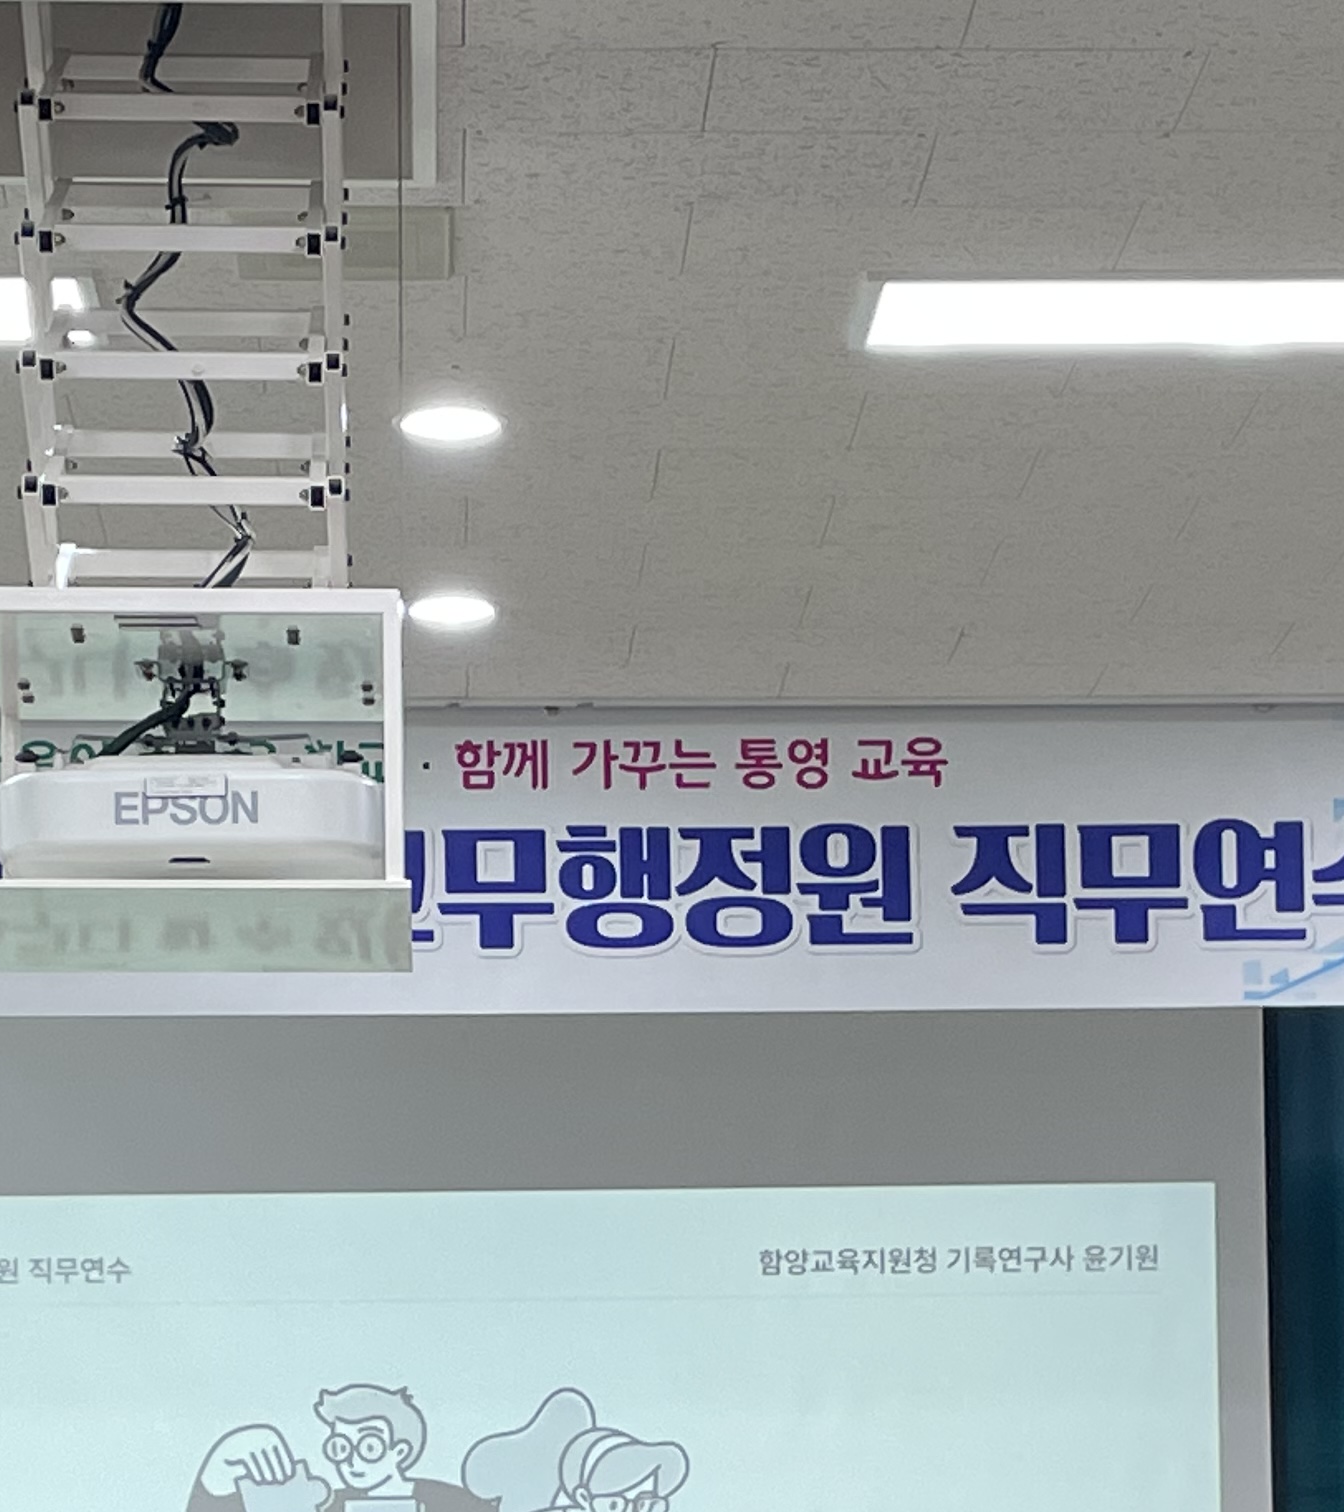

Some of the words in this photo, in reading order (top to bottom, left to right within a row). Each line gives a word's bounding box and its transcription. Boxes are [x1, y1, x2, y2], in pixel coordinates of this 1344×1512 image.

[456, 738, 548, 790] 함께
[572, 738, 717, 790] 가꾸는
[734, 736, 829, 789] 통영
[851, 736, 948, 788] 교육
[113, 790, 259, 826] EPSON
[404, 823, 914, 950] 무행정원
[27, 1256, 132, 1284] 직무연수
[758, 1245, 938, 1276] 함양교육지원청
[946, 1244, 1074, 1273] 기록연구사
[1082, 1242, 1159, 1272] 윤기원
